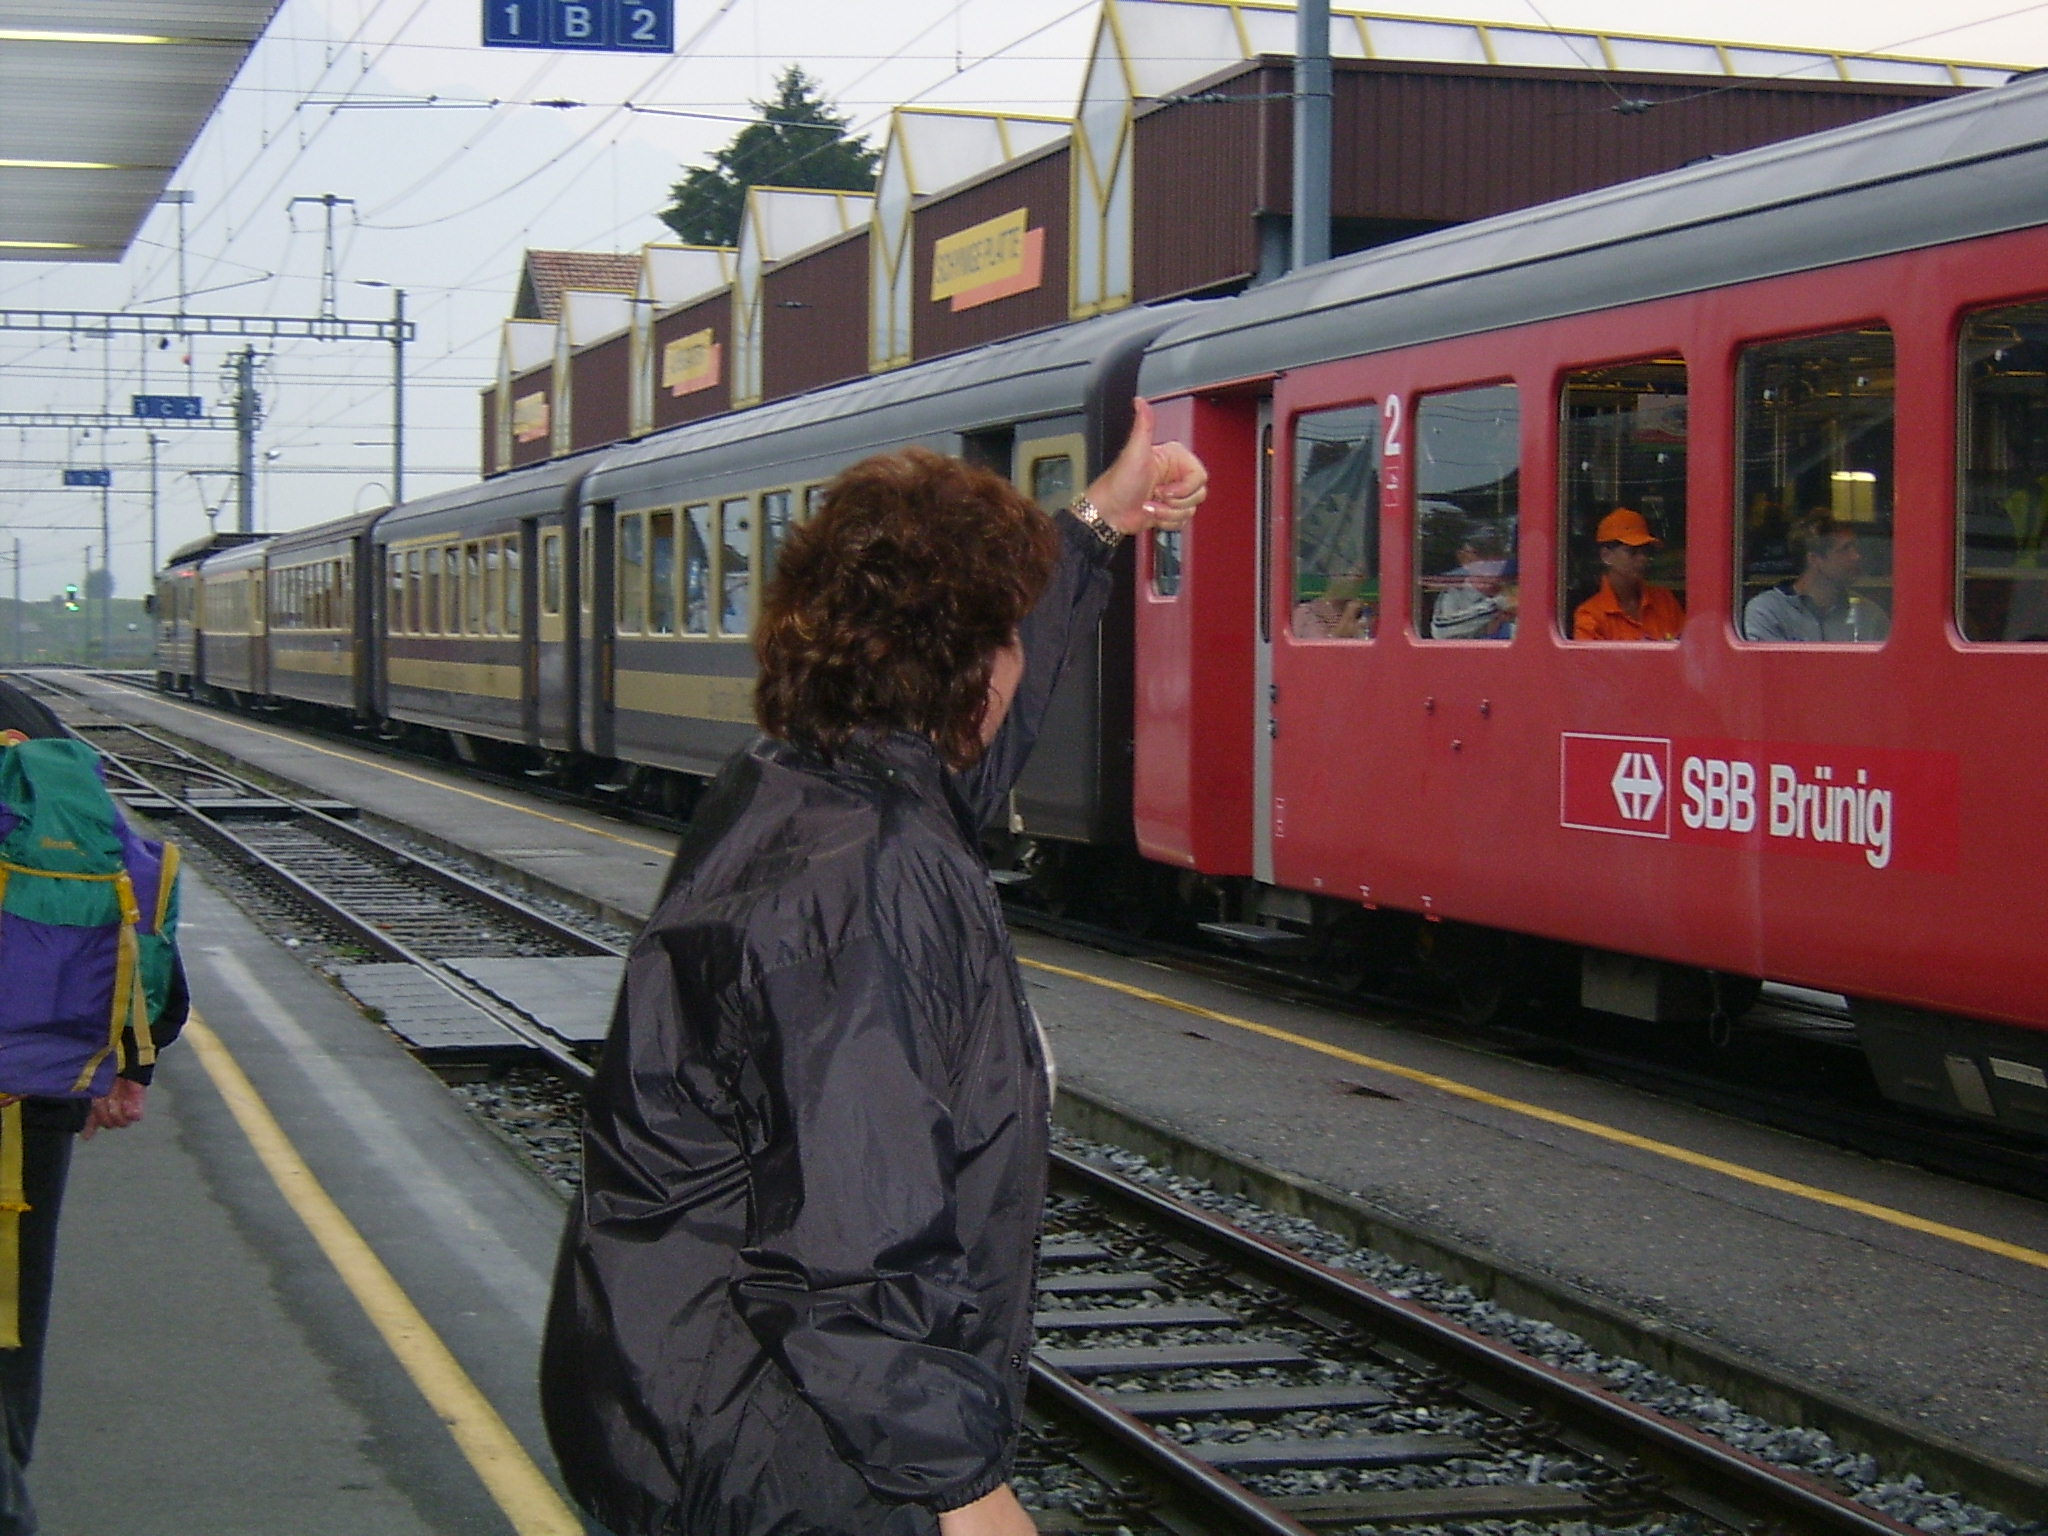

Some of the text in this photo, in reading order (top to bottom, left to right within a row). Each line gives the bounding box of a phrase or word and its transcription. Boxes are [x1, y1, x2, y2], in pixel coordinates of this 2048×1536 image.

[504, 4, 656, 40] 1 B 2
[1384, 394, 1400, 455] 2
[1681, 756, 1893, 870] SBB Brünig
